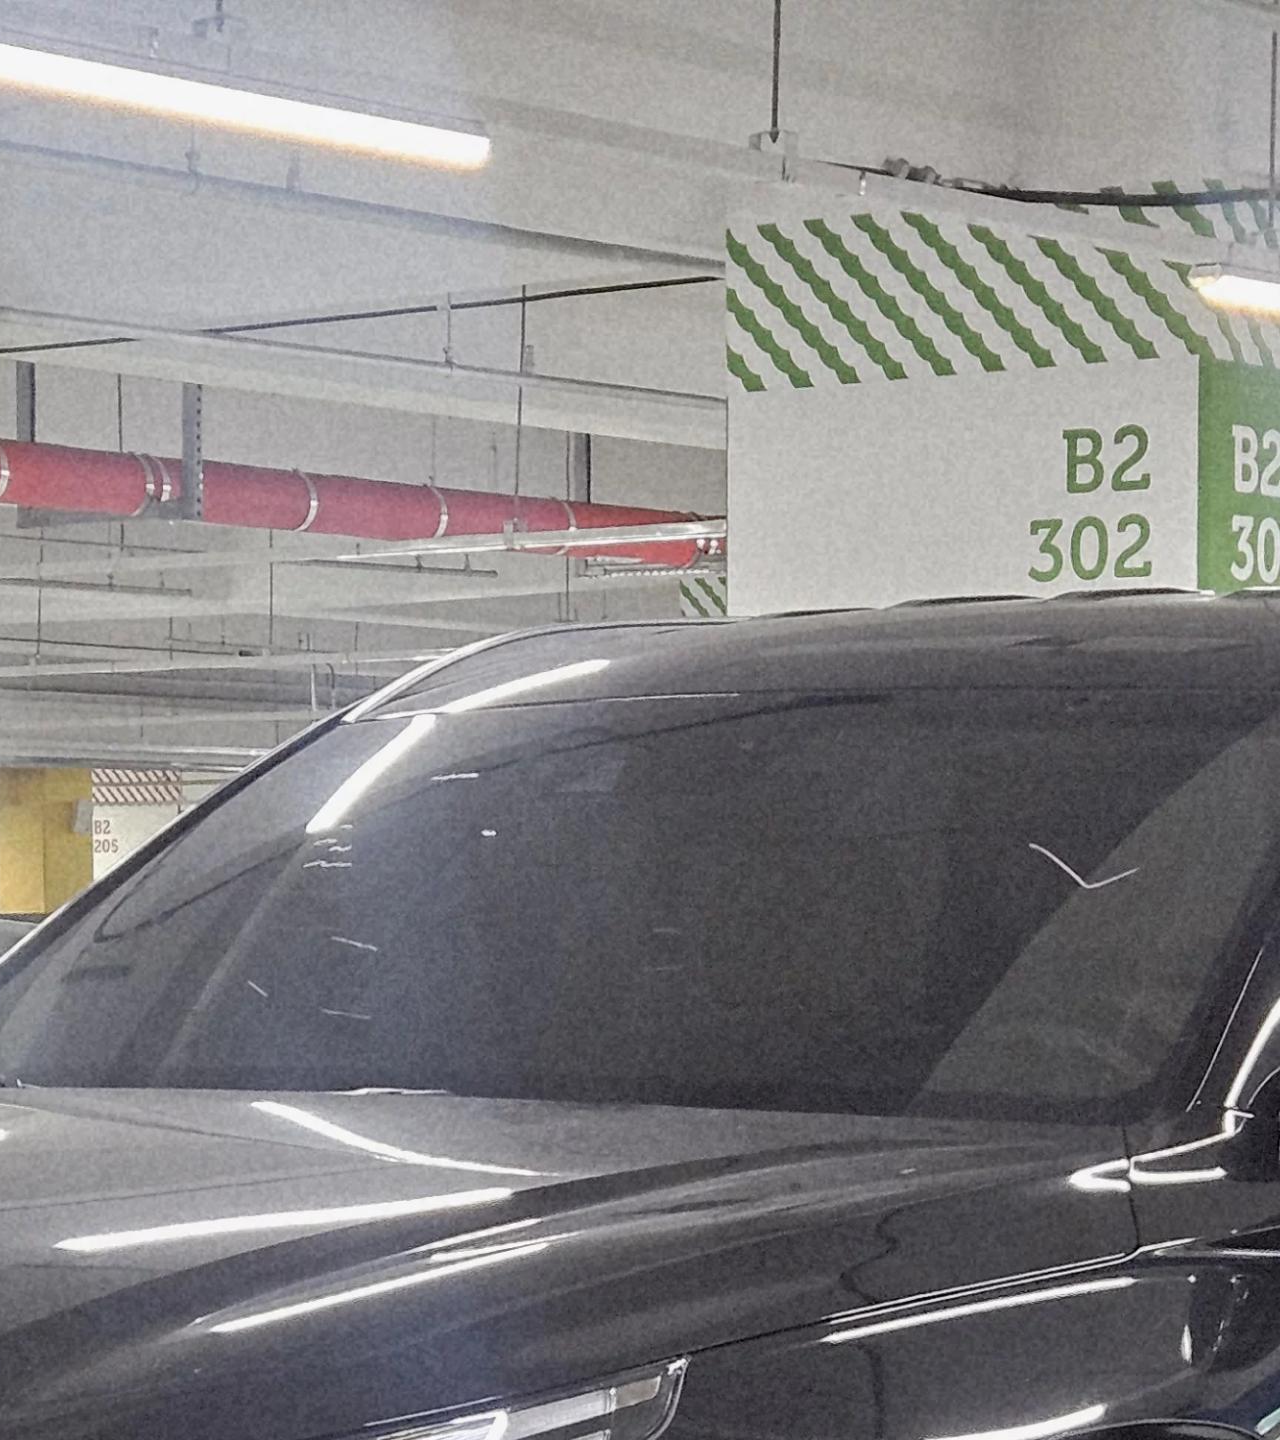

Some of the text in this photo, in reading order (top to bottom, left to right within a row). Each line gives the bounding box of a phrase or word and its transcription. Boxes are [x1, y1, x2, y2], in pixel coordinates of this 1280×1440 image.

[1063, 424, 1151, 494] B2
[1027, 513, 1152, 583] 302
[94, 819, 111, 834] B2
[94, 839, 119, 853] 205
